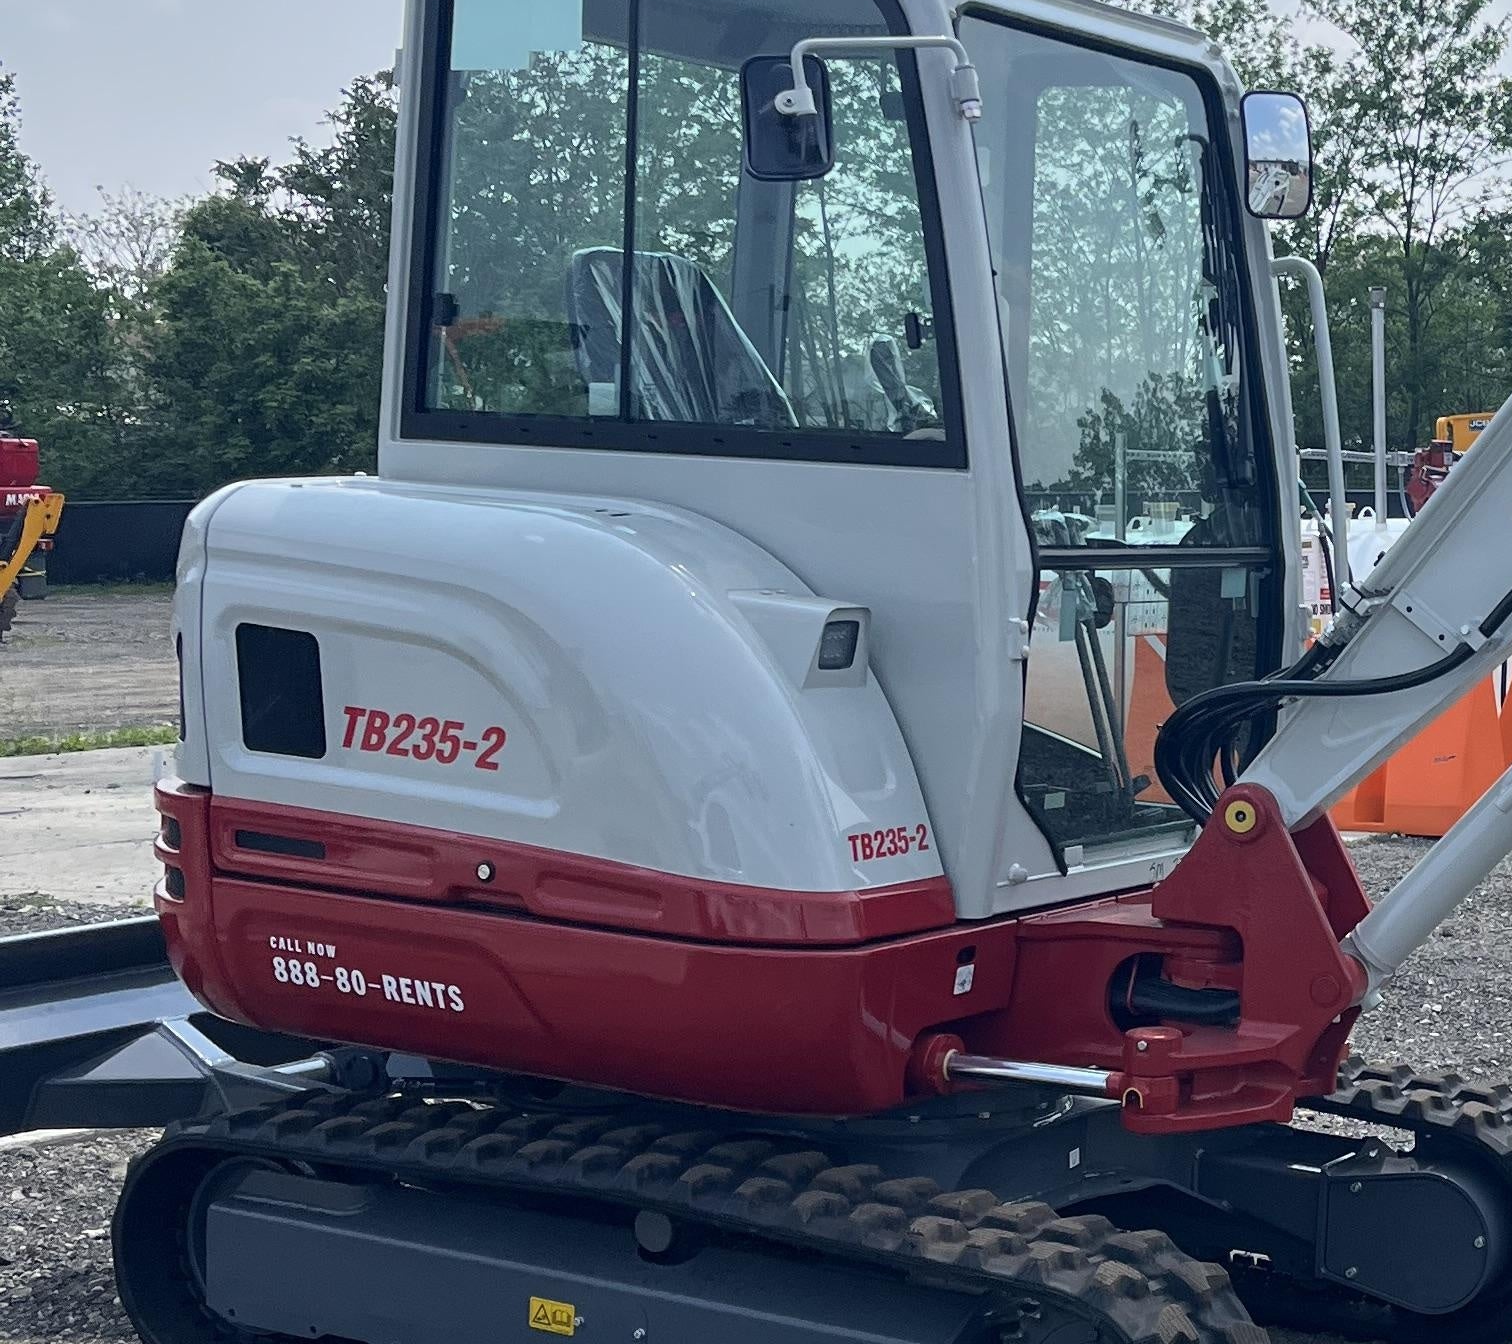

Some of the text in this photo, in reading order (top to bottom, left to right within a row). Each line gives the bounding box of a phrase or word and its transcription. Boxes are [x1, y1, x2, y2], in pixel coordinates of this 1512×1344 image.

[342, 705, 508, 772] TB235-2
[847, 823, 930, 863] TB235-2
[269, 935, 337, 959] CALL NOW
[272, 956, 466, 1013] 888-80-RENTS
